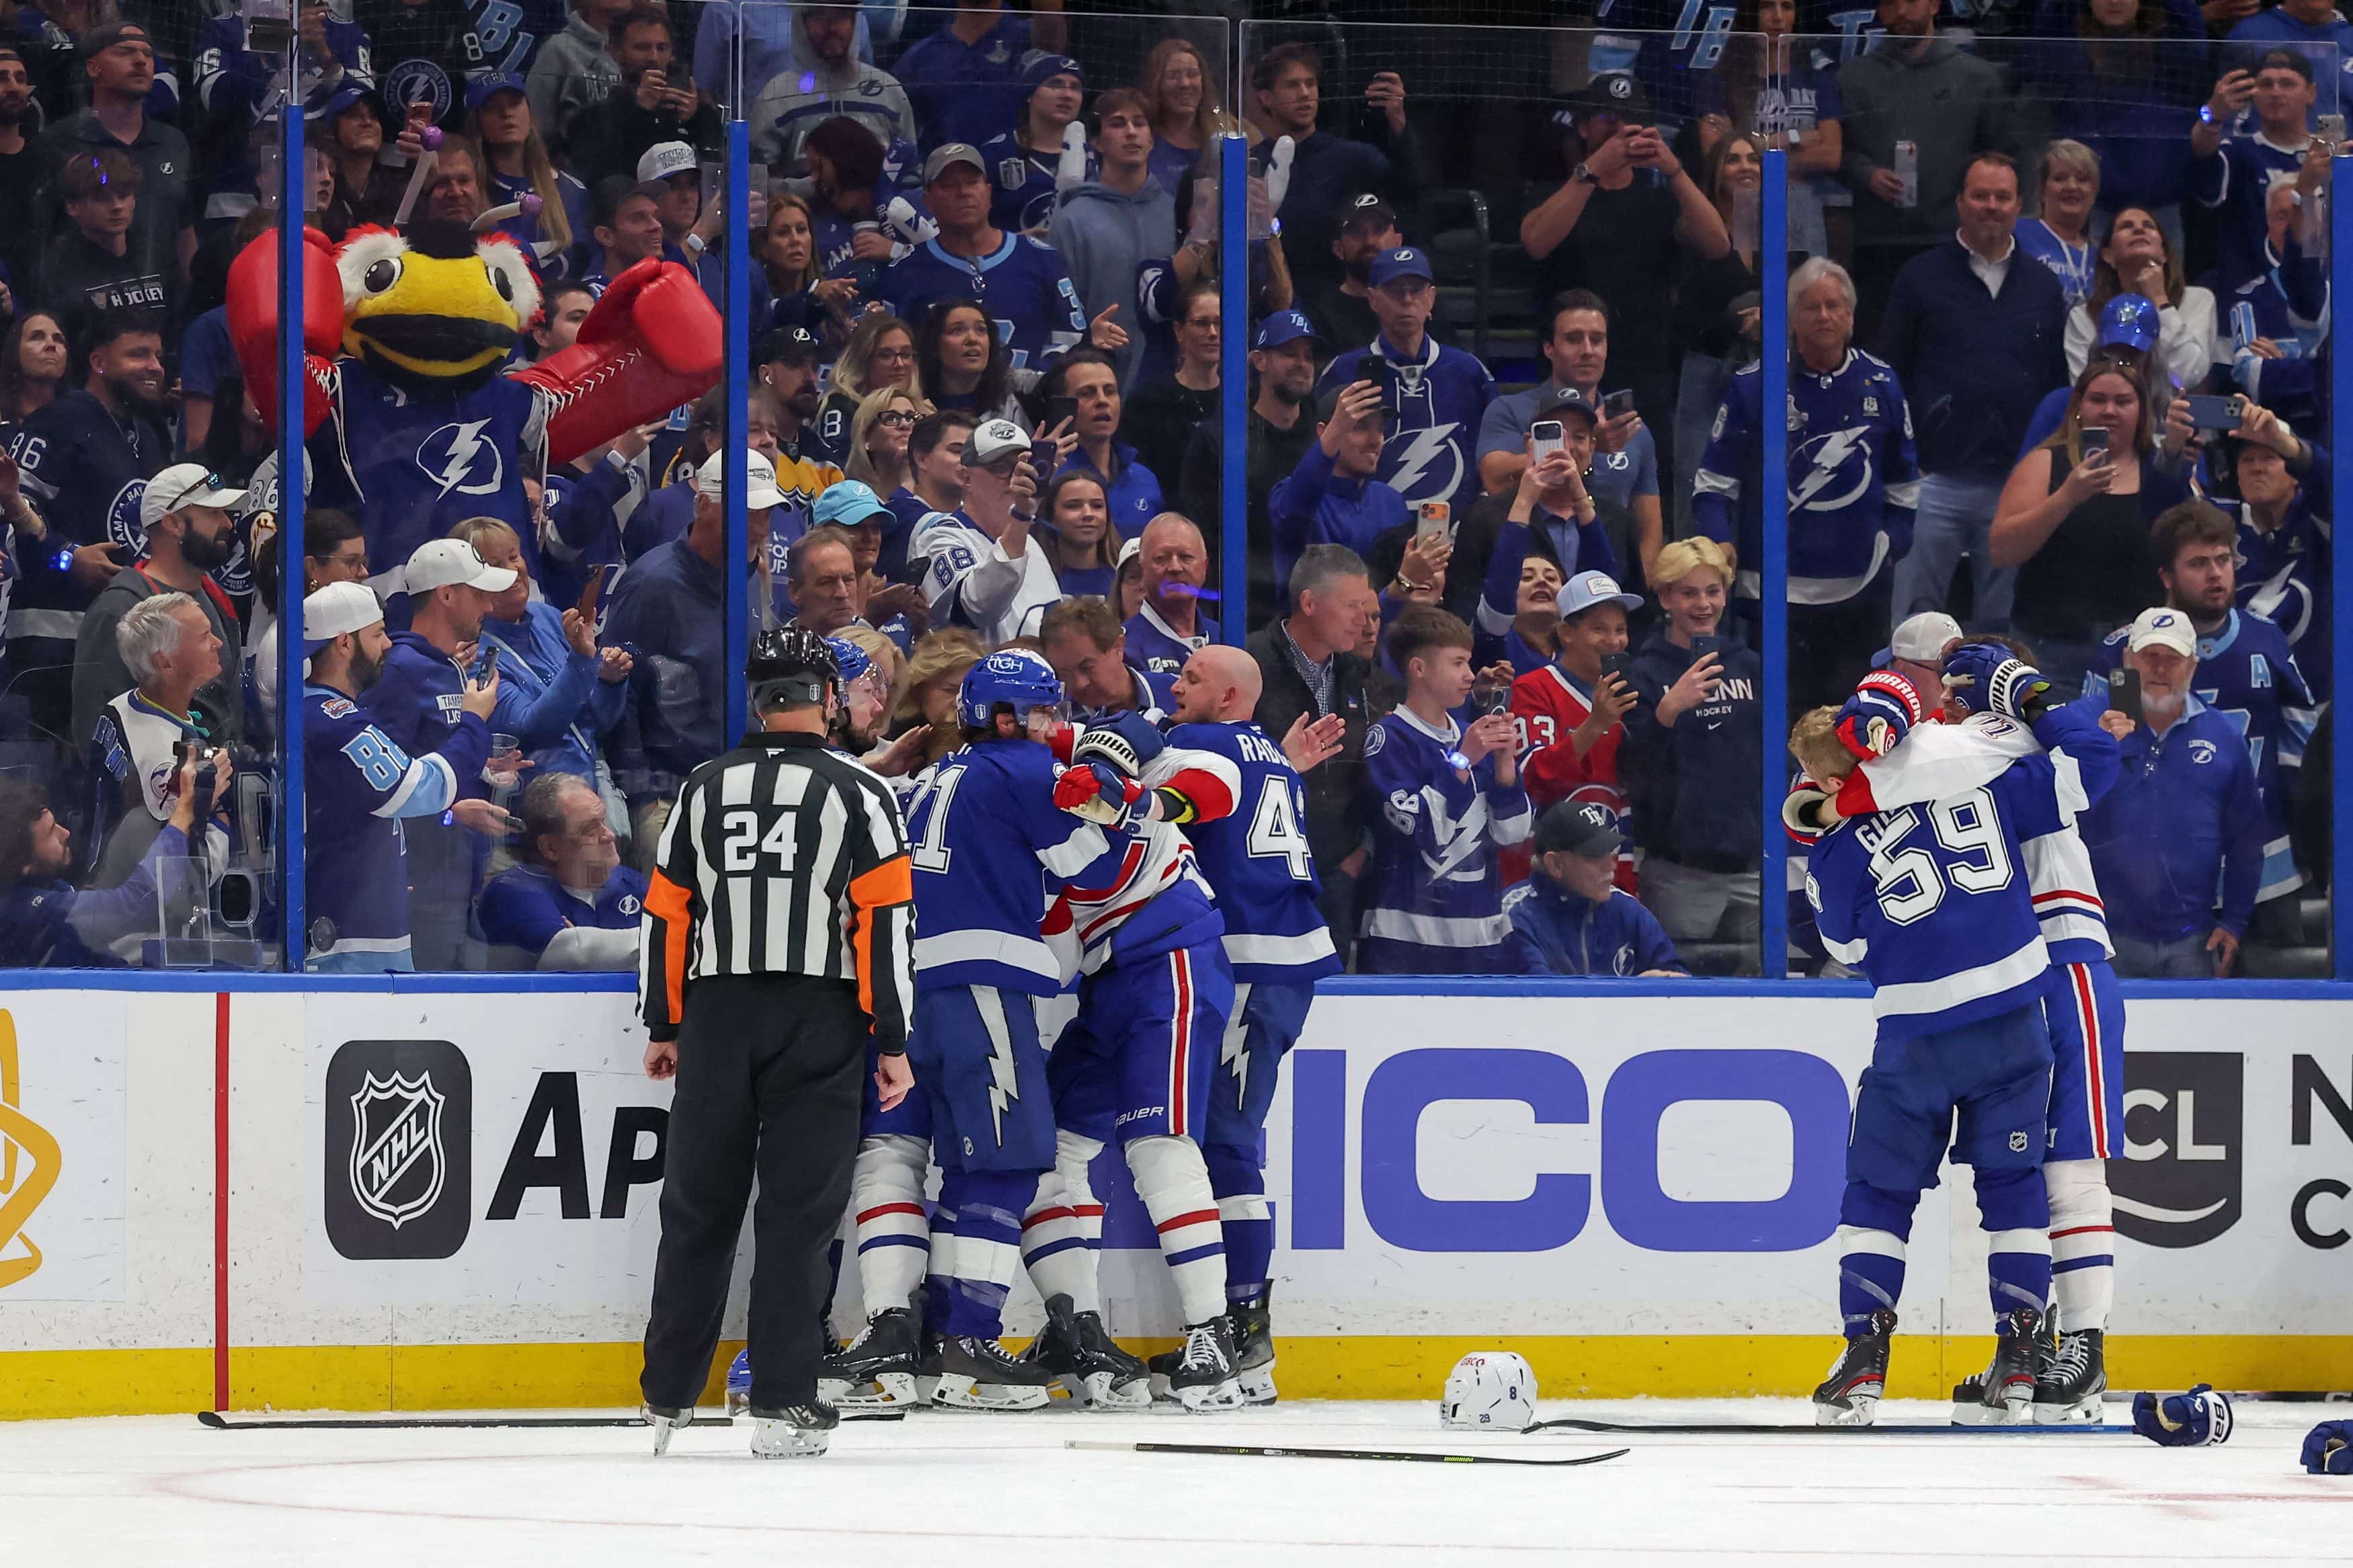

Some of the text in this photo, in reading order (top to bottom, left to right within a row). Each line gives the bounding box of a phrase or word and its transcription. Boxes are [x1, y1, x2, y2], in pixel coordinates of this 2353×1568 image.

[463, 32, 483, 61] 8
[1290, 313, 1310, 334] TBL
[824, 410, 842, 438] 8
[7, 432, 47, 470] 86
[932, 548, 975, 589] 88
[990, 657, 1024, 671] TGH
[2249, 653, 2272, 689] A
[1696, 705, 1732, 718] HOCKEY
[1859, 672, 1921, 723] WARRIOR
[906, 762, 967, 874] 71
[1246, 774, 1313, 881] 4
[1579, 806, 1605, 827] TB
[723, 811, 798, 872] 24
[1868, 786, 2014, 927] 59
[370, 1111, 426, 1193] NHL
[1089, 1047, 1852, 1252] ICO
[1509, 1386, 1517, 1401] 8
[1478, 1413, 1491, 1423] 29
